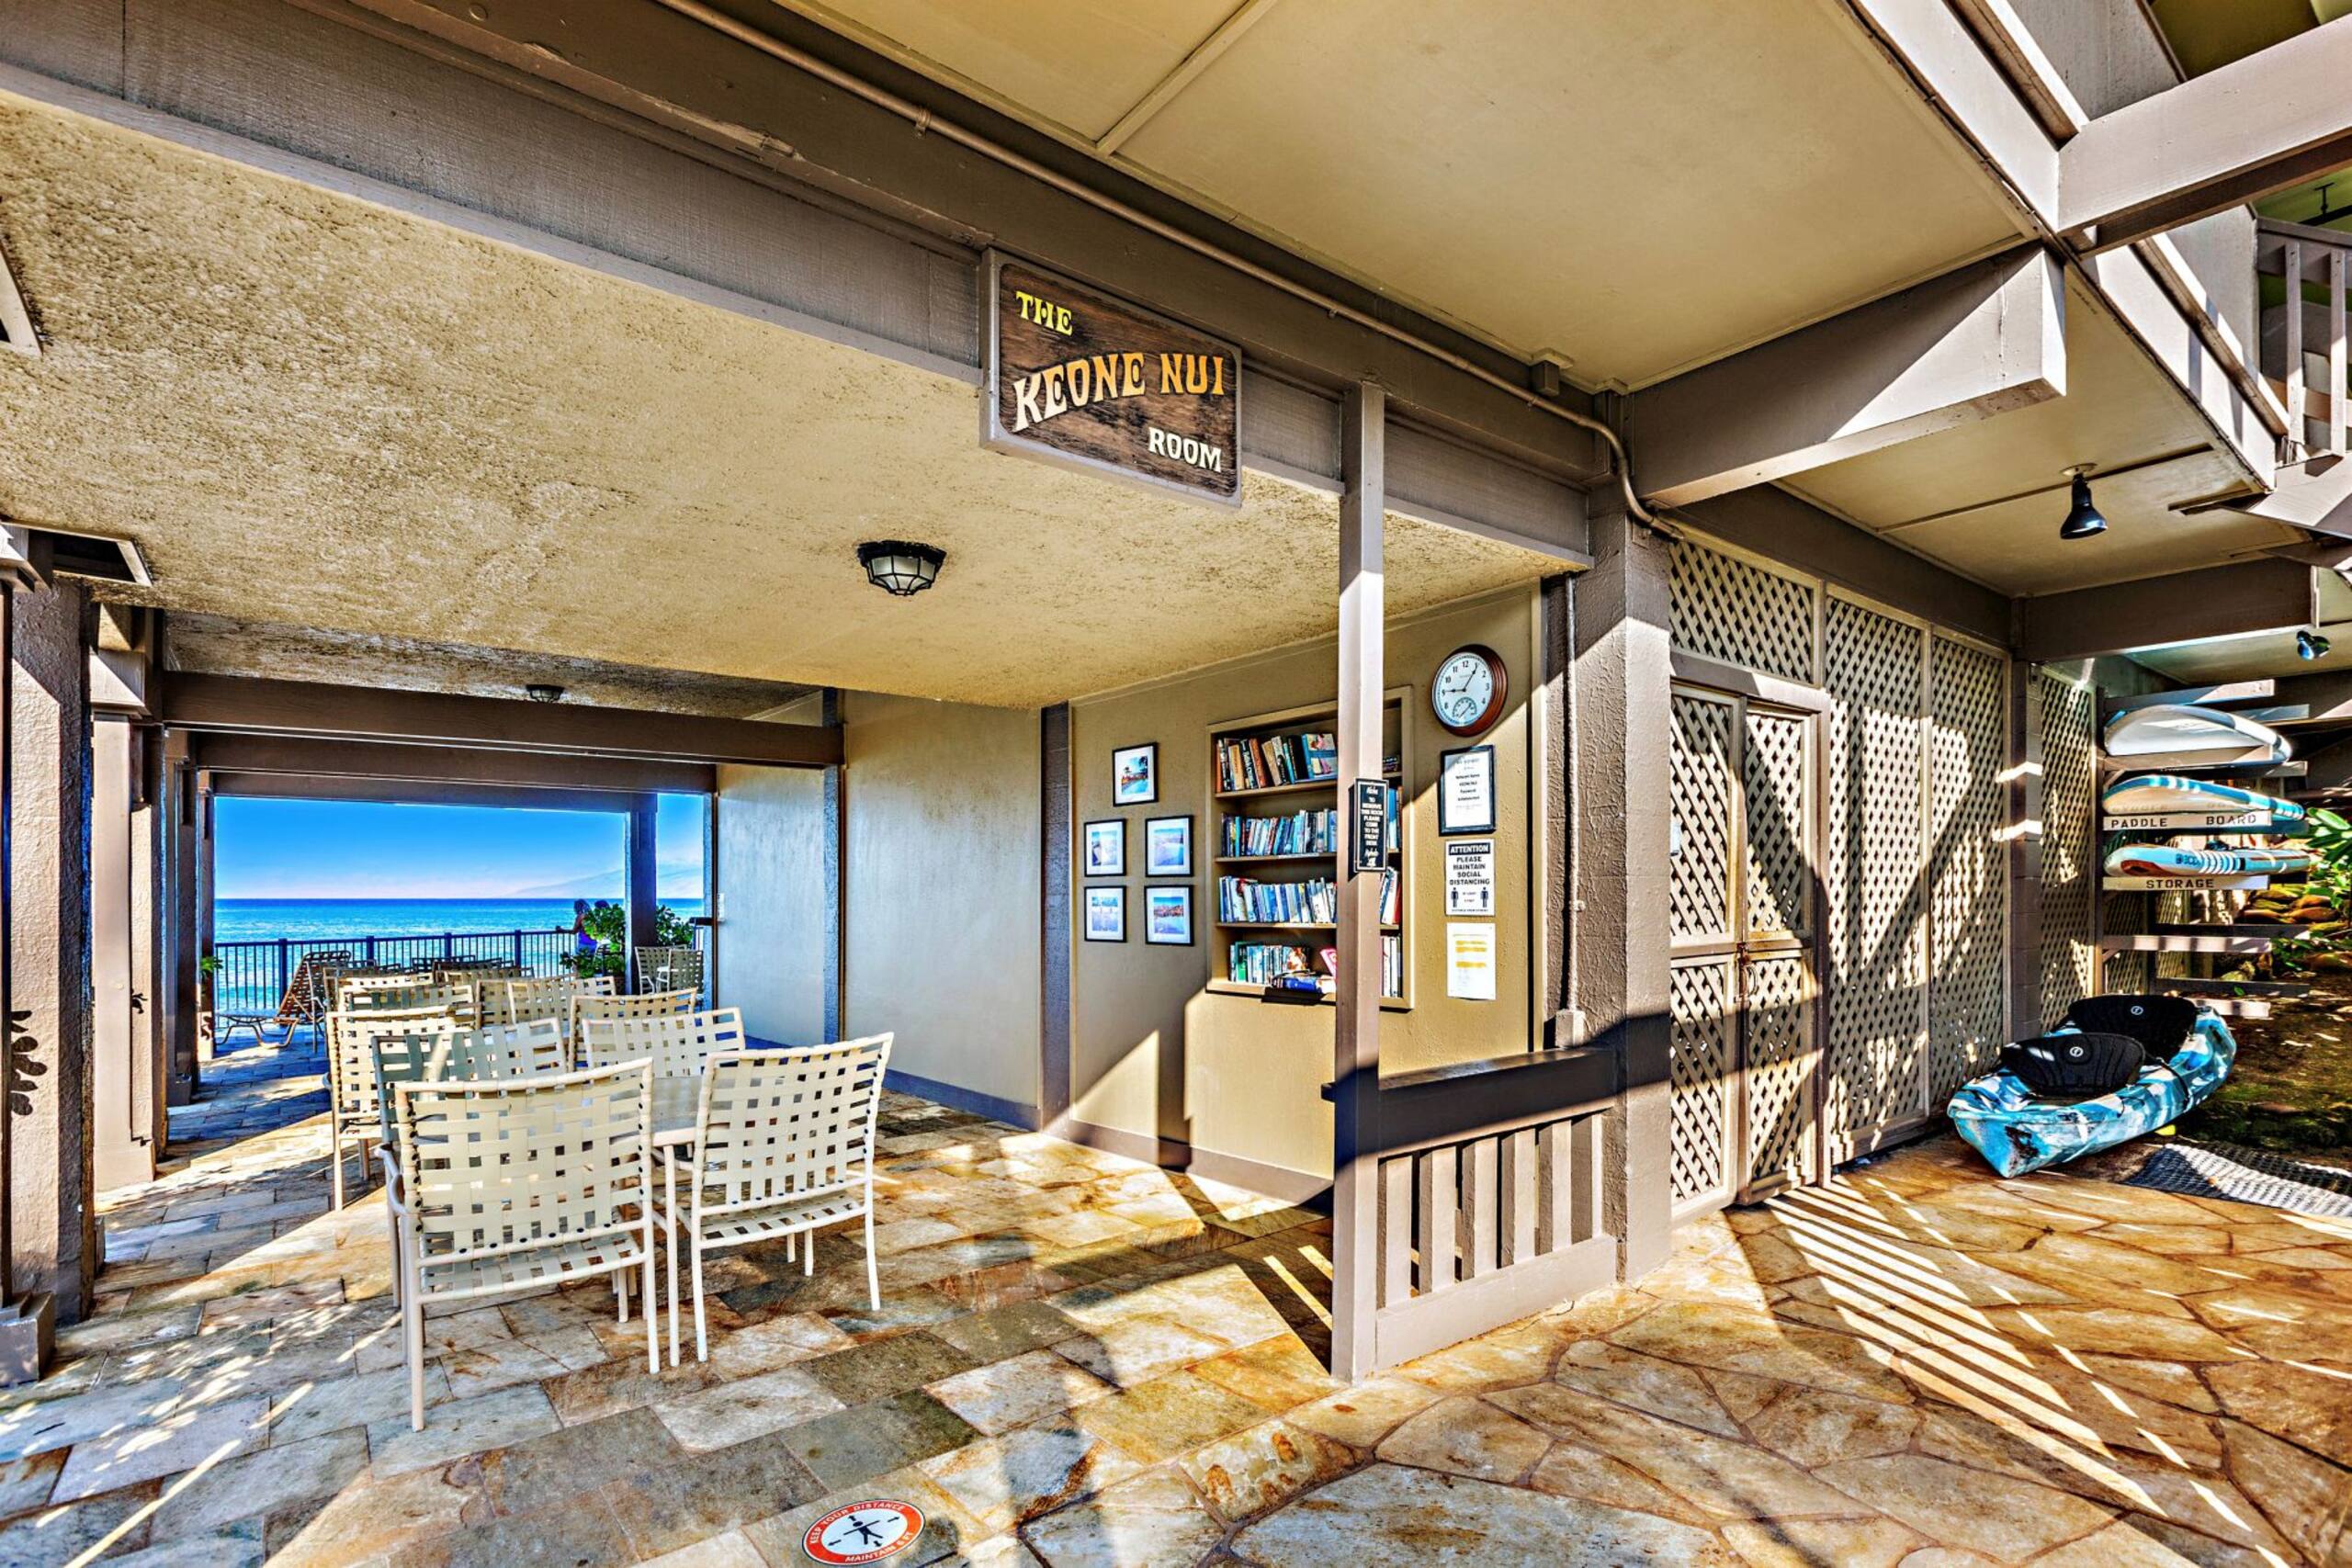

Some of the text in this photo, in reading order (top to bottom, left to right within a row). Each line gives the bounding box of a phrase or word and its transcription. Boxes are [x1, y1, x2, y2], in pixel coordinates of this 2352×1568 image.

[1015, 291, 1073, 335] THE
[1012, 352, 1226, 433] KEONE NUI
[1148, 426, 1222, 473] ROOM
[2111, 814, 2256, 829] PADDLE BOARD
[1450, 844, 1489, 853] ATTENTION
[2146, 879, 2214, 888] STORAGE
[822, 1509, 850, 1525] YOUR
[853, 1502, 906, 1512] DISTANCE
[845, 1545, 897, 1562] MAINTAIN
